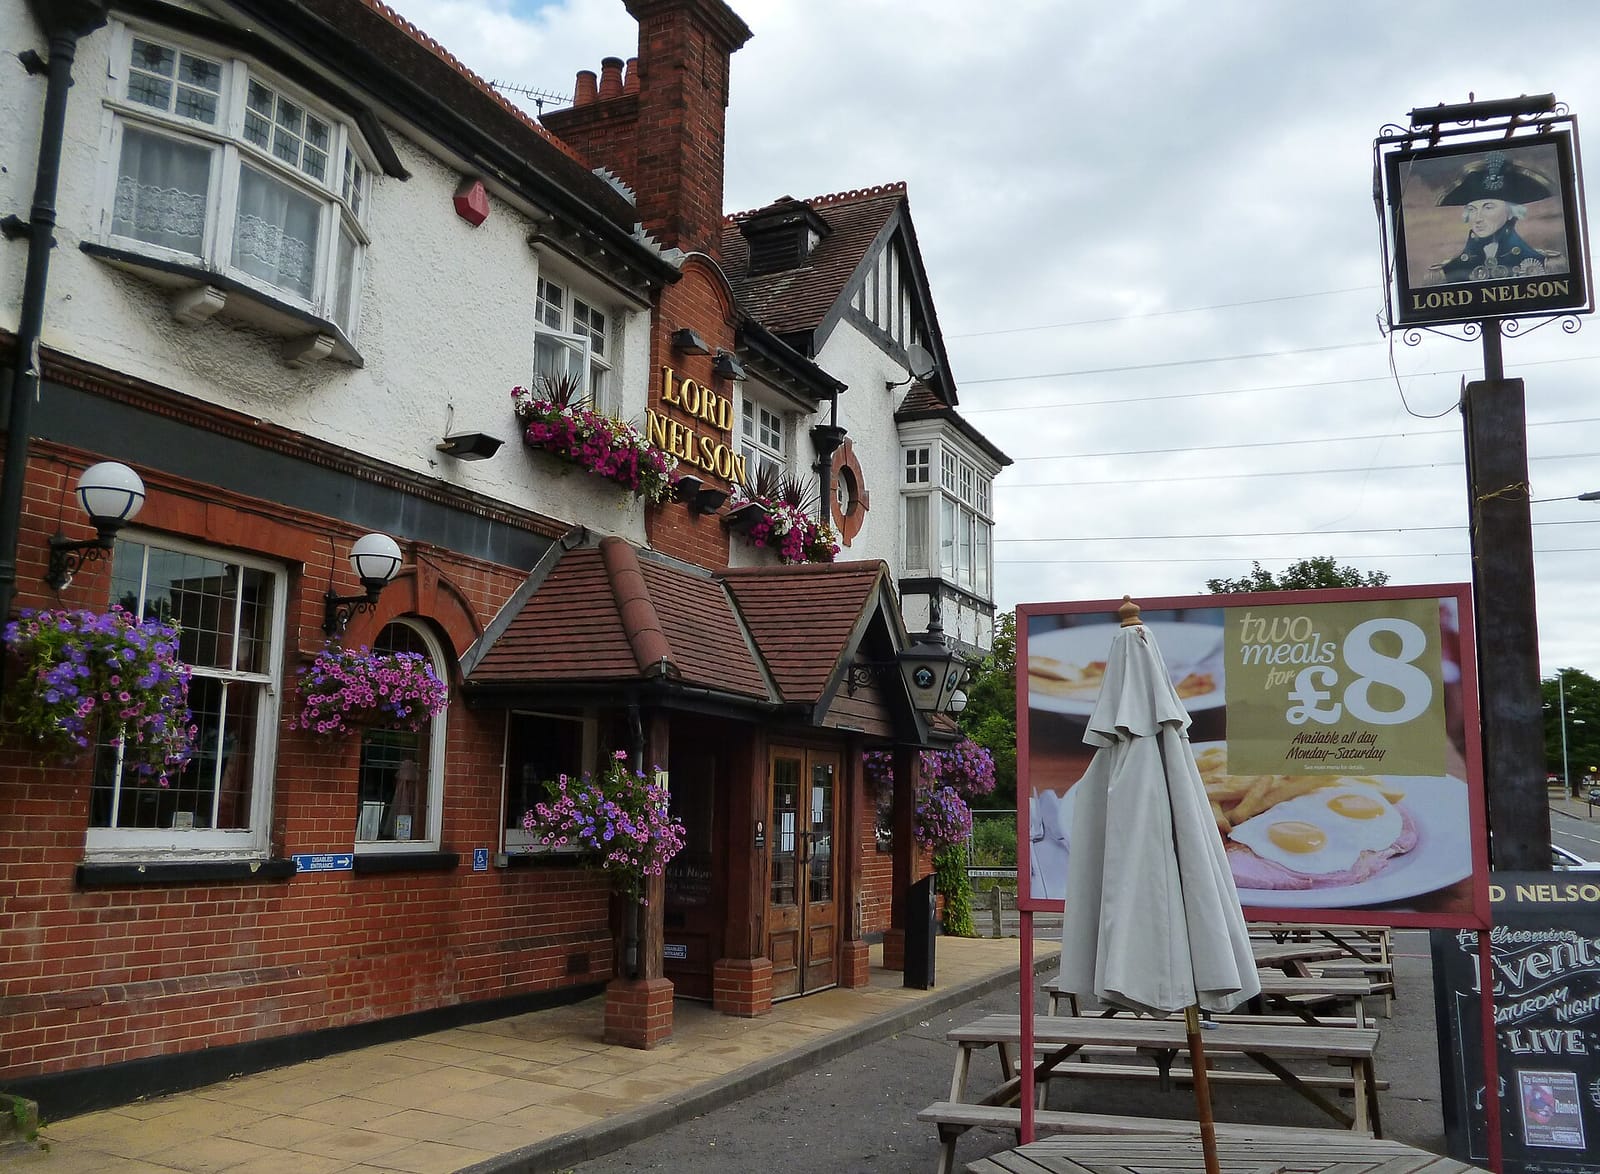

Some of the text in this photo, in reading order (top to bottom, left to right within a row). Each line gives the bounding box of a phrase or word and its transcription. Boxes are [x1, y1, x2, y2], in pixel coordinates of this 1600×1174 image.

[1413, 280, 1570, 310] LORD NELSON
[662, 365, 734, 431] LORD
[645, 408, 746, 487] NELSON
[1239, 612, 1313, 644] two
[1239, 632, 1337, 665] meals
[1264, 666, 1296, 690] for
[1291, 730, 1379, 746] Available all day
[1507, 1029, 1588, 1055] LIVE
